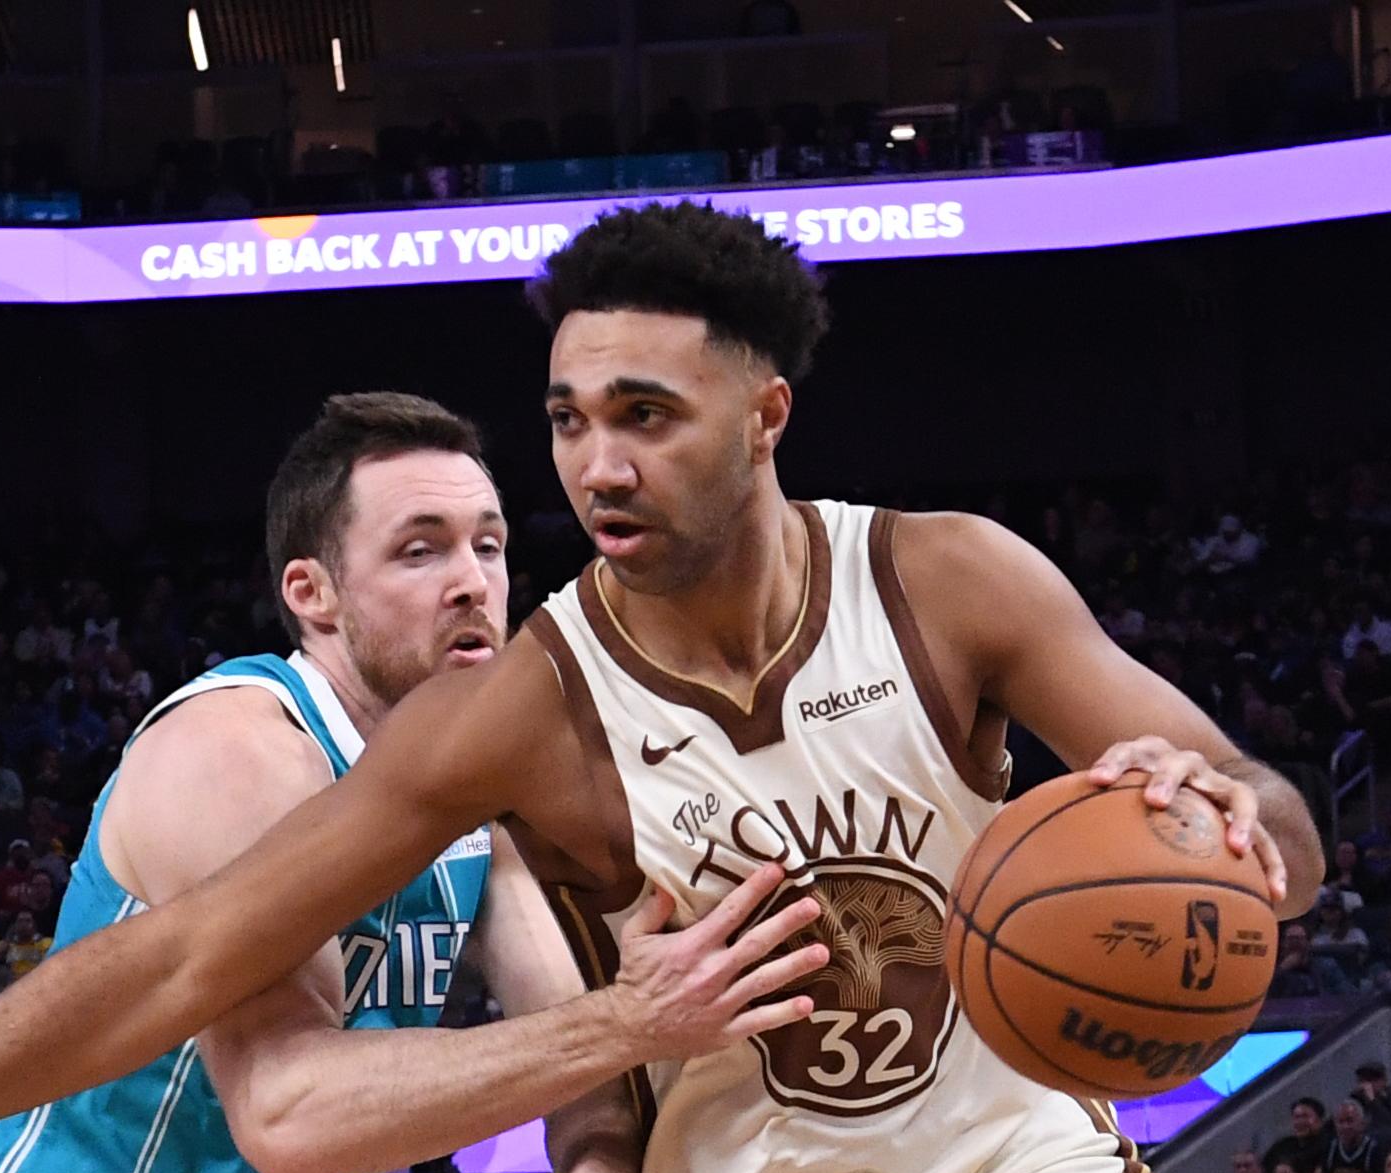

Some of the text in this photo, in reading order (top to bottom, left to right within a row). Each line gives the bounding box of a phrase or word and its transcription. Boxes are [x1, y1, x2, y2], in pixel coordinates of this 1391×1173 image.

[141, 242, 256, 281] CASH
[265, 233, 381, 275] BACK
[389, 230, 443, 267] AT
[795, 201, 965, 245] STORES
[799, 679, 898, 722] Rakuten
[672, 792, 721, 847] The
[689, 788, 936, 888] TOWN
[807, 1008, 916, 1087] 32
